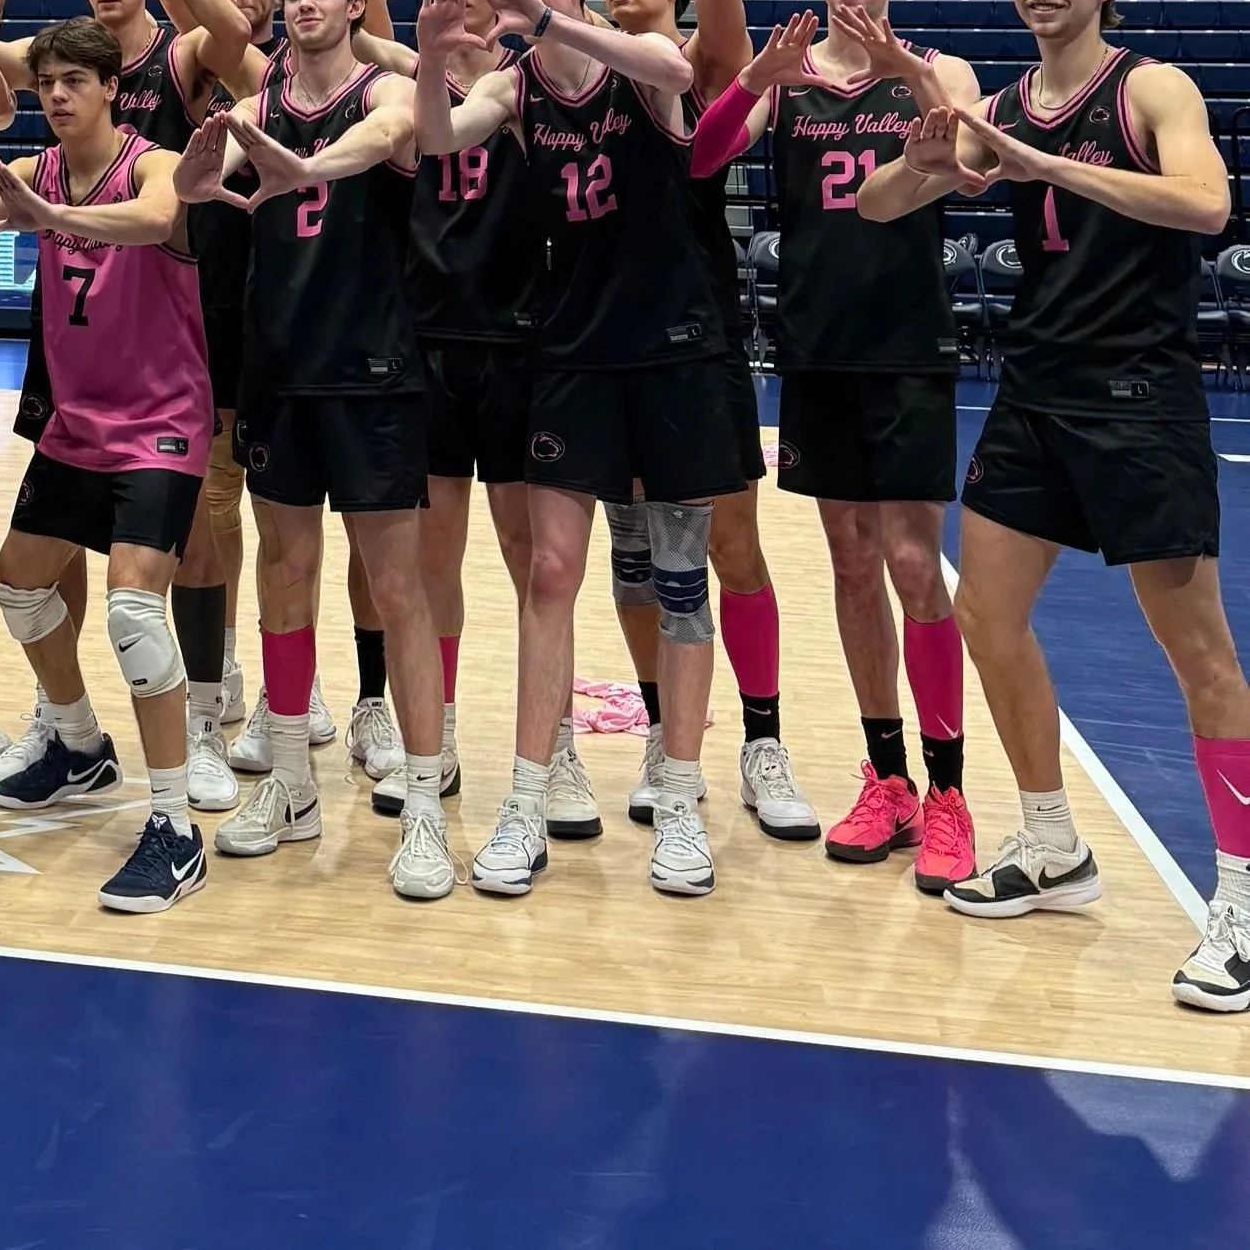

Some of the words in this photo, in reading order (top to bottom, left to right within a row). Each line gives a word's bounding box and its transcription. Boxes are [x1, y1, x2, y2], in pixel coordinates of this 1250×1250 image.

[791, 114, 850, 141] Happy
[854, 112, 912, 140] Valley
[438, 148, 488, 201] 18
[560, 154, 617, 223] 12
[821, 150, 878, 210] 21
[297, 181, 328, 237] 2
[1043, 186, 1070, 252] 1
[63, 265, 96, 326] 7
